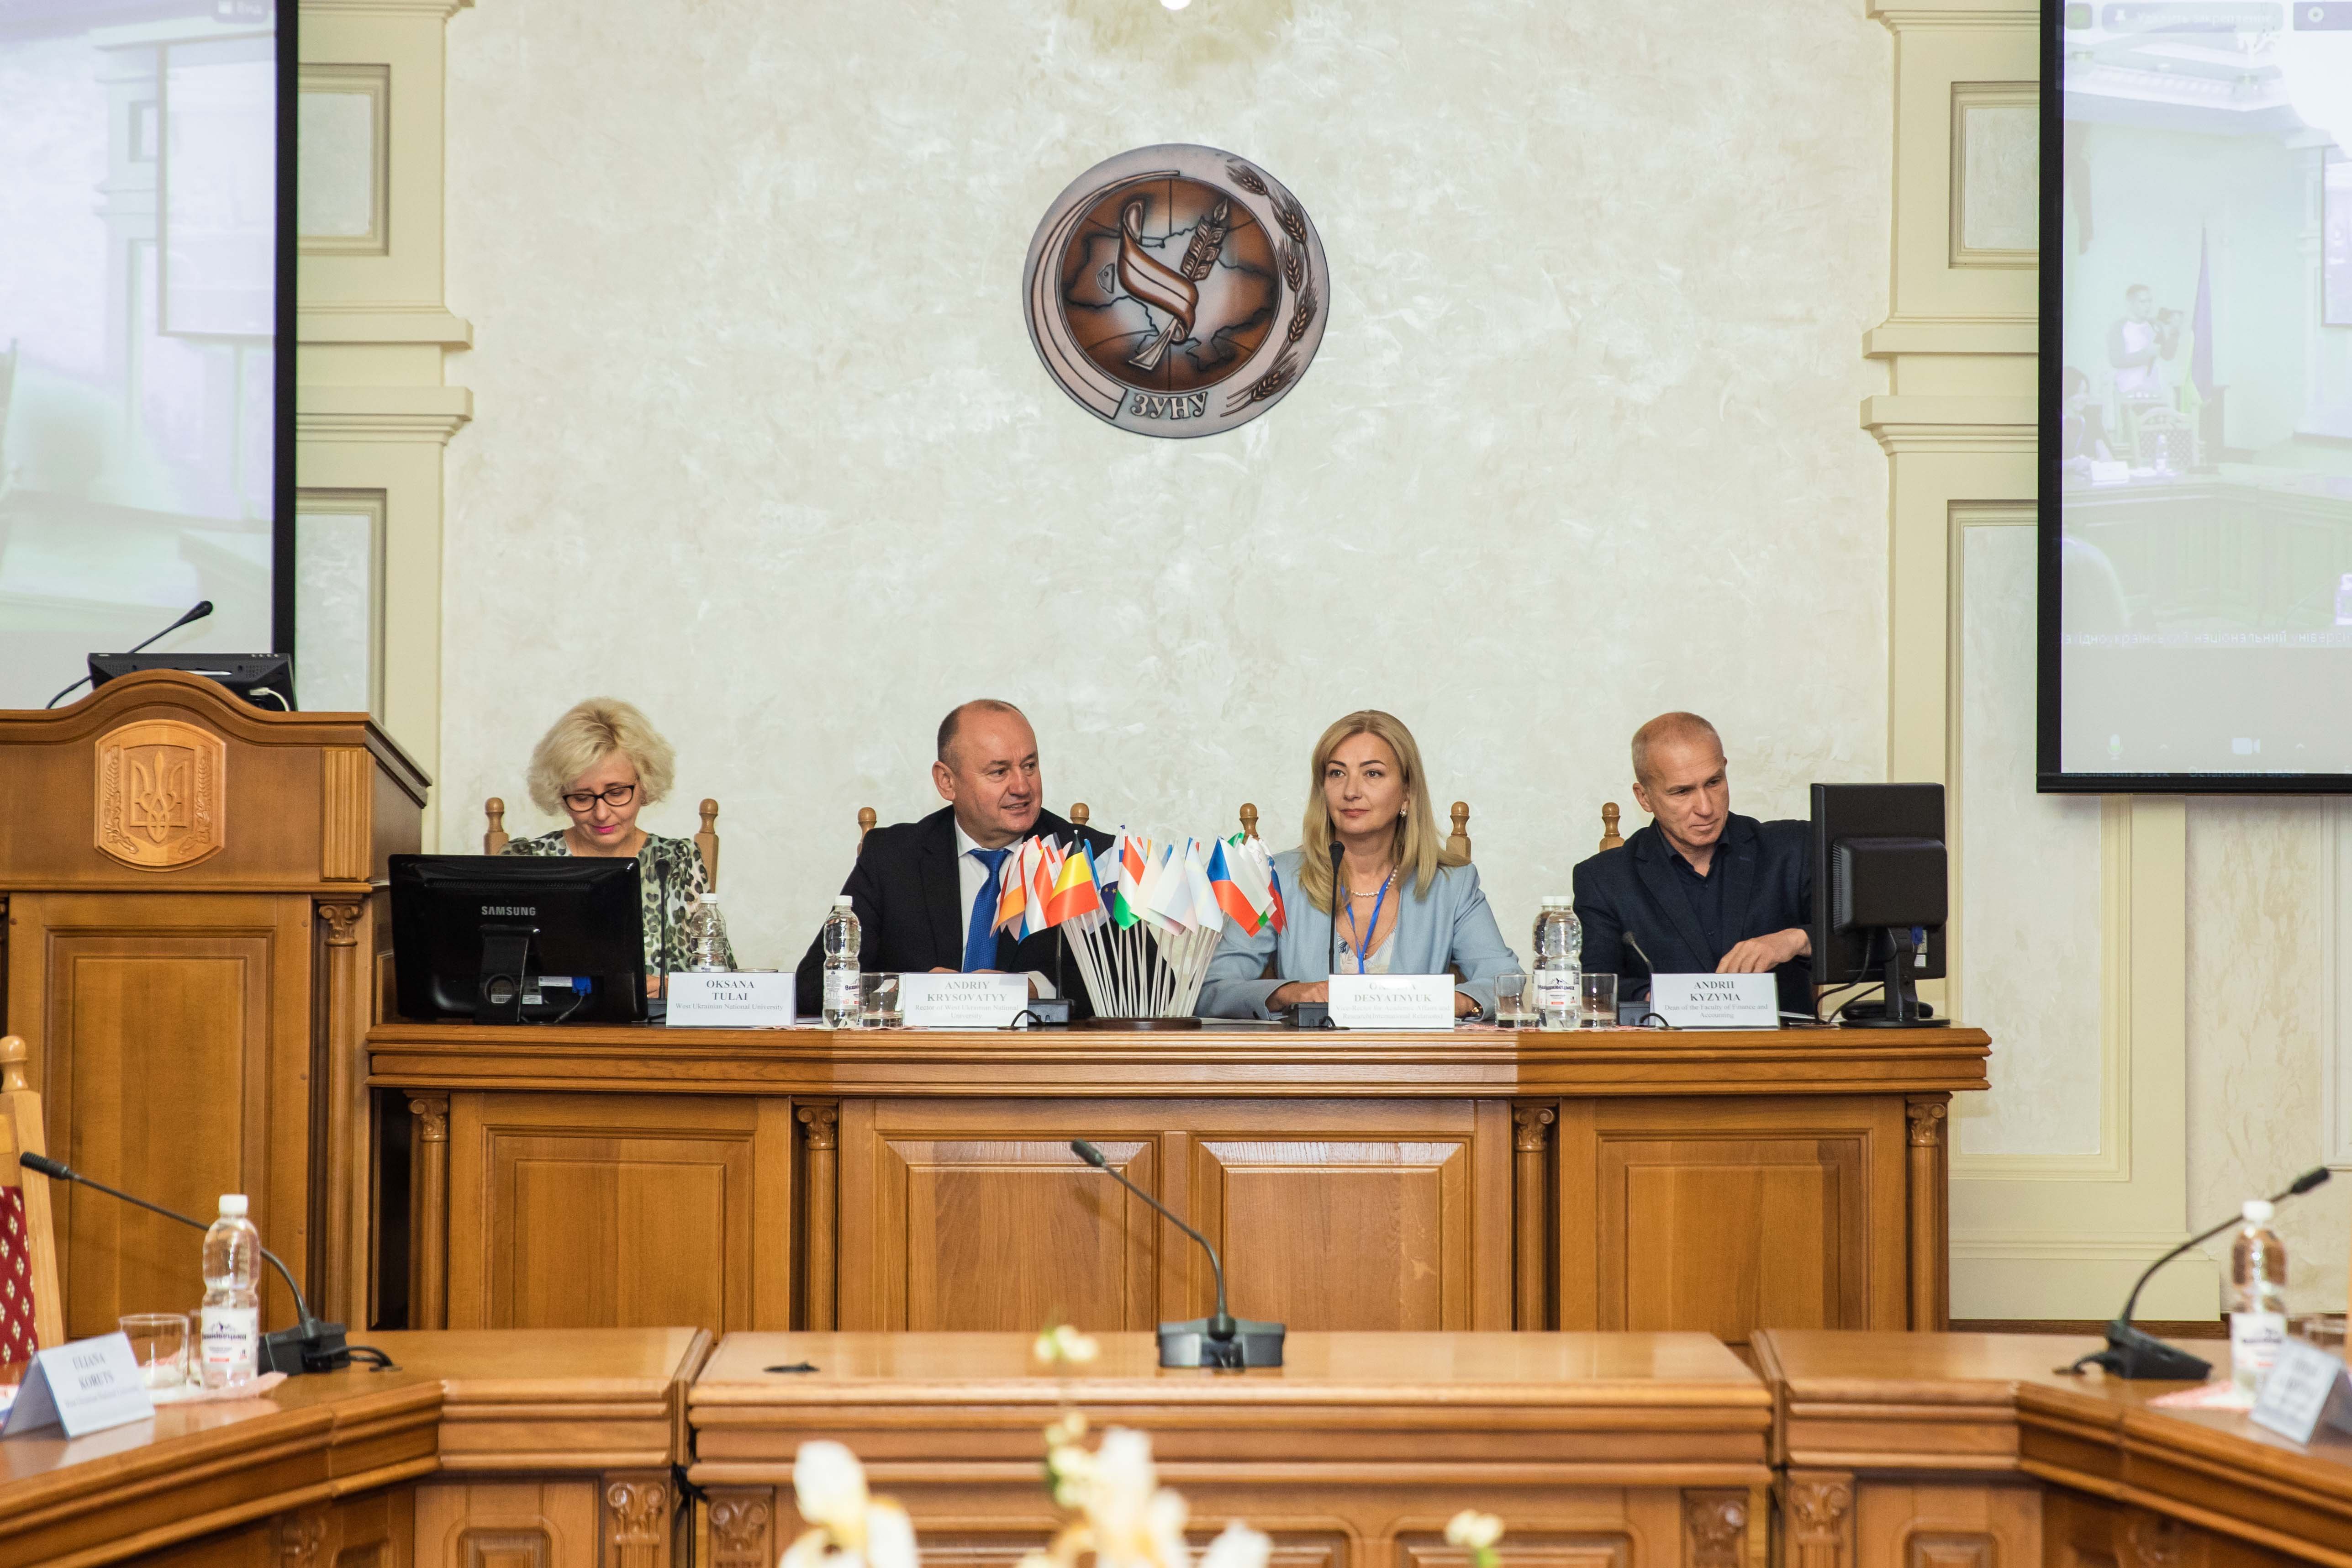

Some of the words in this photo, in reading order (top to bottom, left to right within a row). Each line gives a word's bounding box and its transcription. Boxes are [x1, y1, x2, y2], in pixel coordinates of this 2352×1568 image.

[1130, 391, 1208, 419] ЗУНУ
[2194, 630, 2287, 644] національний
[481, 906, 536, 916] SAMSUNG
[706, 980, 754, 988] OKSANA
[945, 981, 990, 990] ANDRIY
[1694, 981, 1735, 989] ANDRII
[712, 992, 748, 1001] TULAI
[927, 993, 1007, 1002] KRYSOVATYY
[1355, 994, 1432, 1002] DESYATNYUK
[1690, 993, 1740, 1001] KYZYMA
